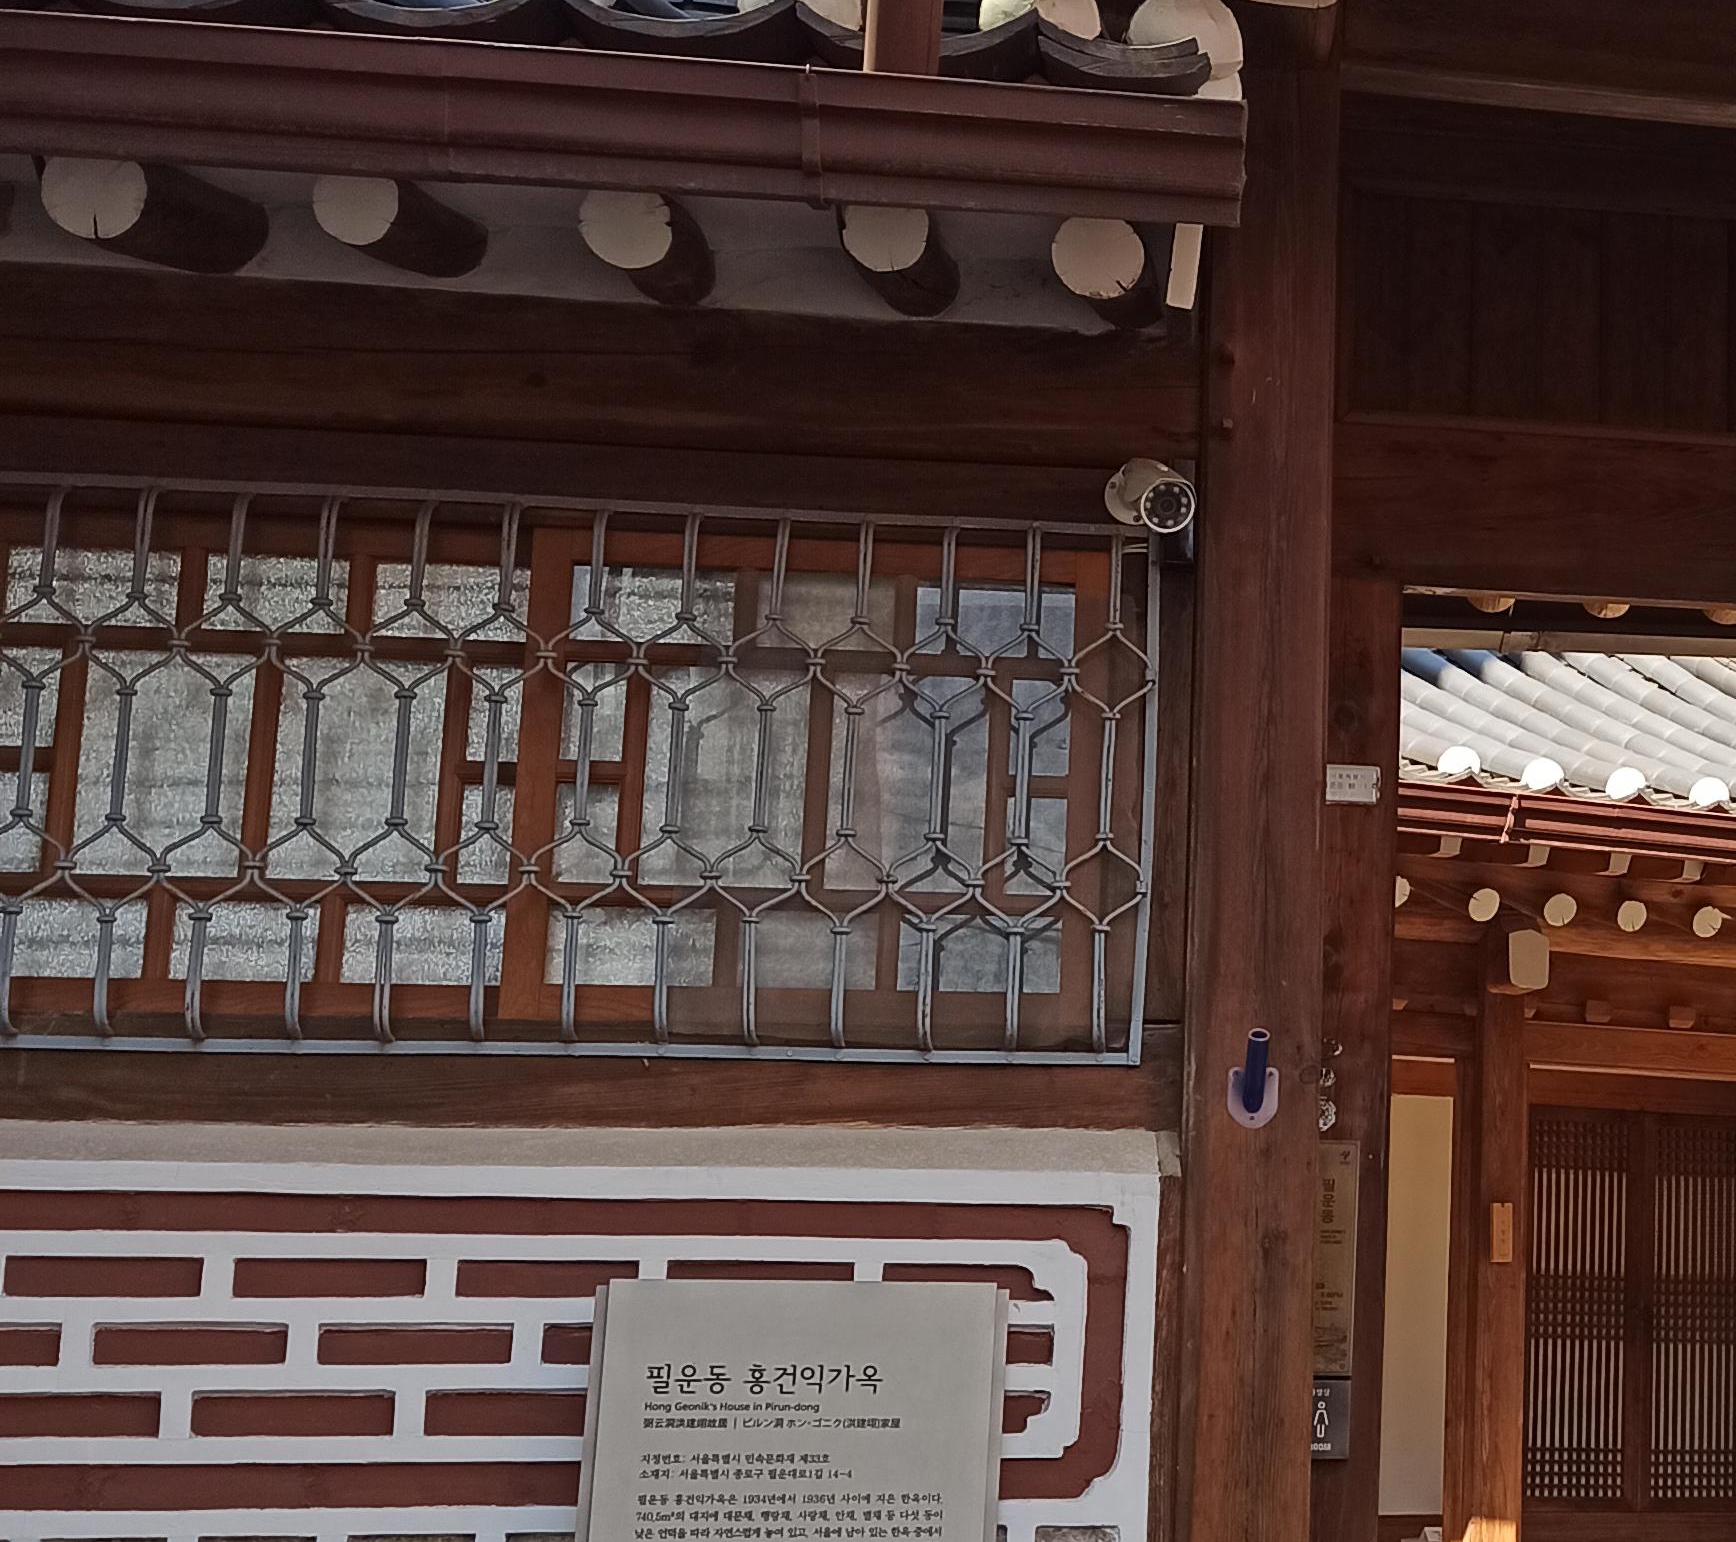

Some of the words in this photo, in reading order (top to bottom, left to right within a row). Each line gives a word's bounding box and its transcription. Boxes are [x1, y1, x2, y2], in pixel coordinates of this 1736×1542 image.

[646, 1363, 732, 1395] 필운동
[742, 1363, 884, 1395] 홍건익가옥
[643, 1402, 673, 1413] Hong
[673, 1401, 718, 1411] Geonik's
[718, 1402, 751, 1411] House
[752, 1402, 764, 1410] in
[764, 1402, 820, 1413] Pirun-dong
